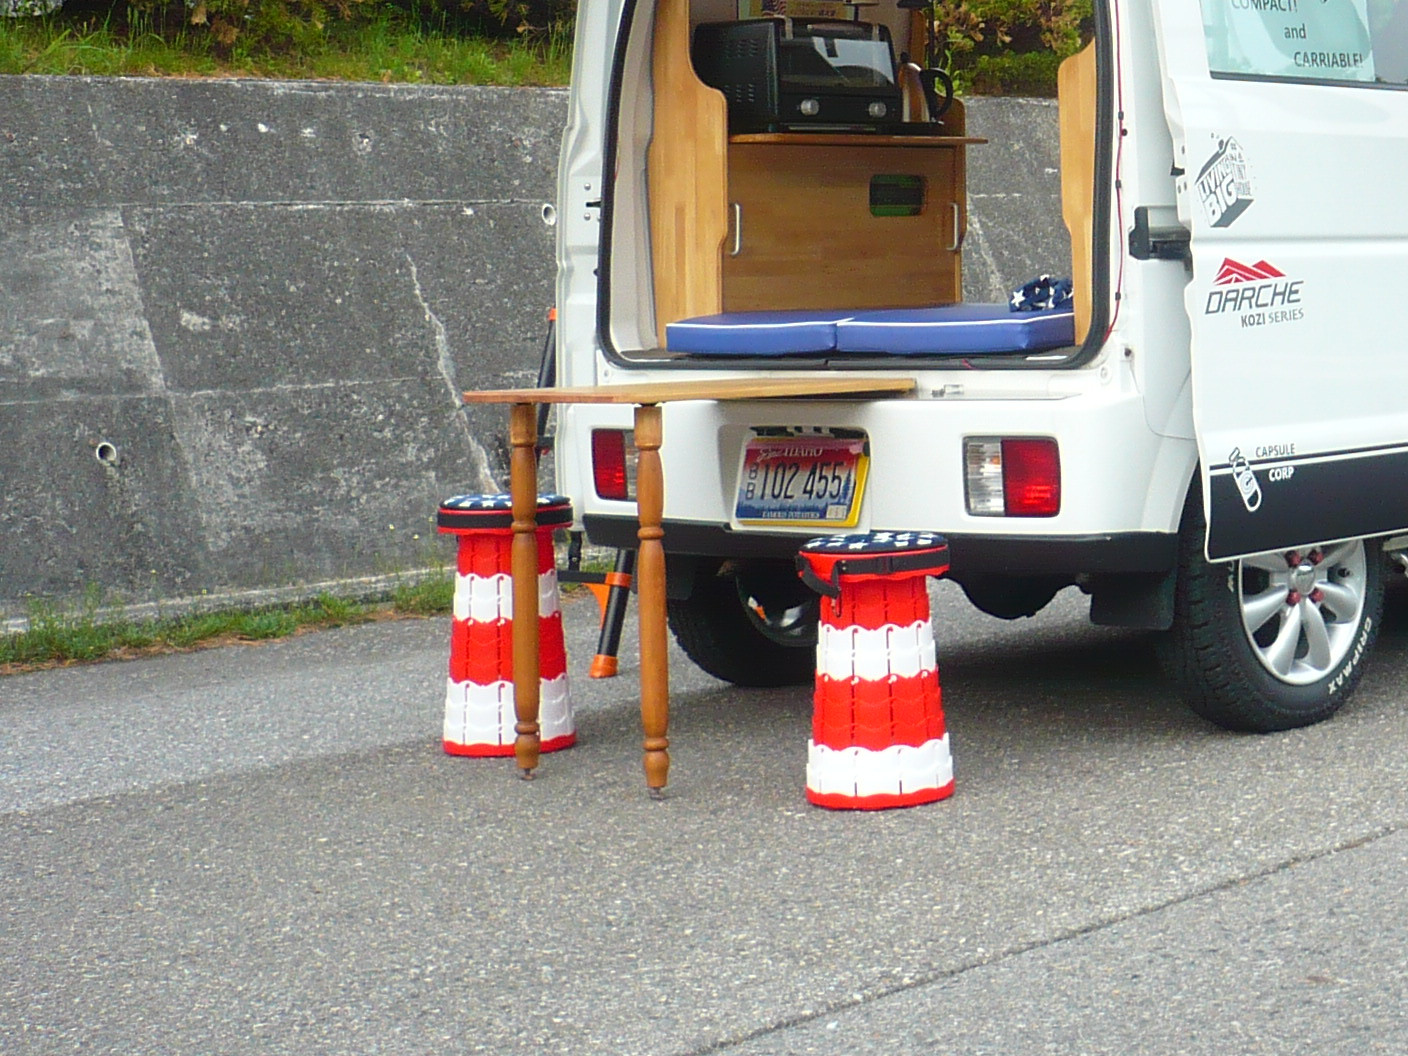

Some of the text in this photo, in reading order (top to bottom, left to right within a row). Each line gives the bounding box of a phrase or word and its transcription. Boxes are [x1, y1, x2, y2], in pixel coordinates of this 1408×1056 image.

[1284, 24, 1307, 39] and
[1294, 51, 1364, 68] CARRIABLE!
[1203, 173, 1239, 227] BIG
[1205, 281, 1304, 315] DARCHE
[1241, 307, 1304, 328] KOZI SERIES
[1256, 443, 1296, 458] CAPSULE
[760, 462, 800, 500] 102
[803, 461, 845, 499] 455
[1268, 466, 1295, 482] CORP
[1328, 616, 1372, 695] GRIPMAX
